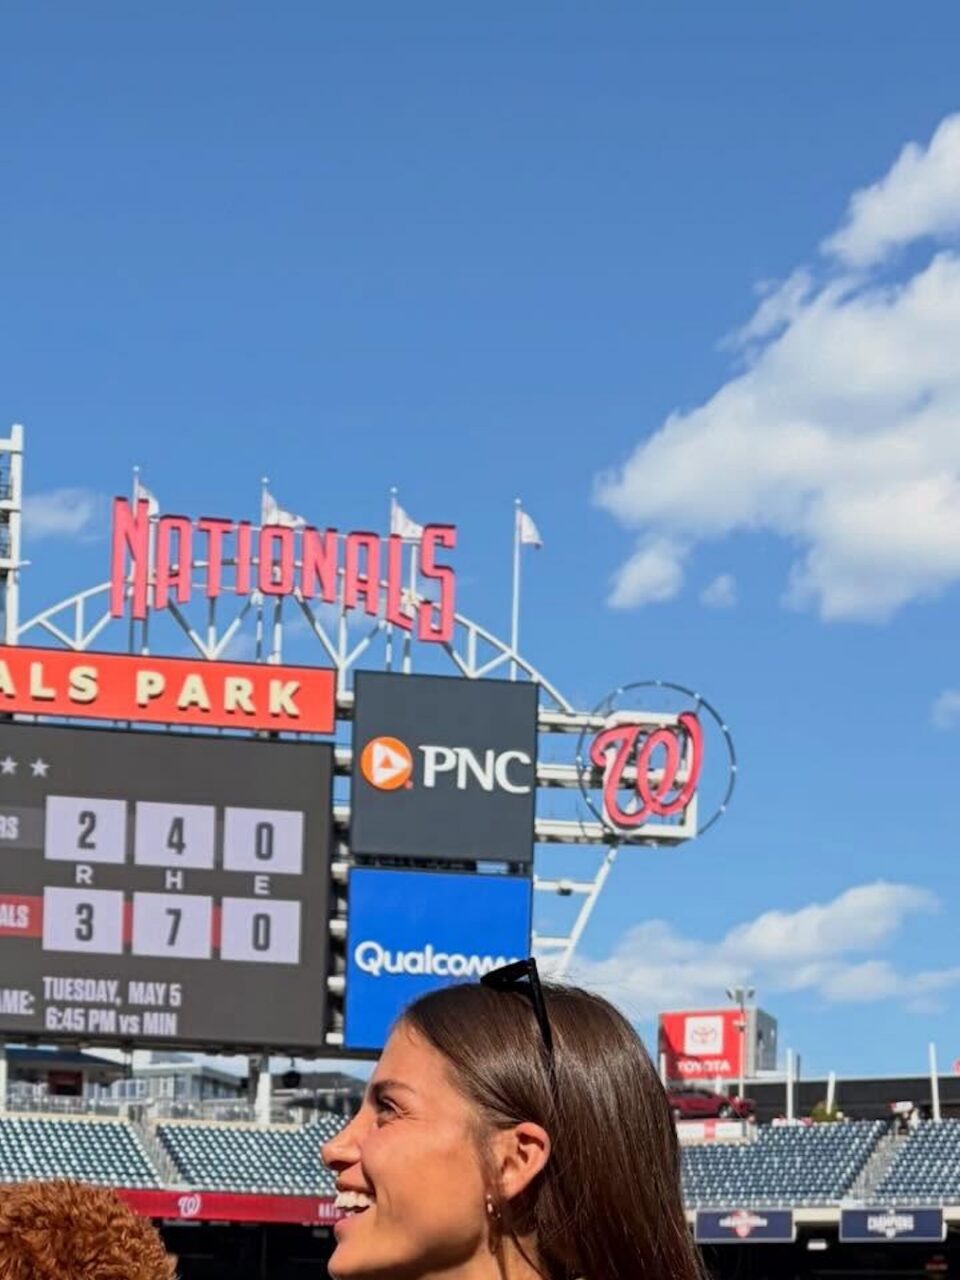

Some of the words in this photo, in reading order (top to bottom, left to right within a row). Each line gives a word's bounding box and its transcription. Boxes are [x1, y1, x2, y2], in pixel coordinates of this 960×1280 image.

[110, 497, 456, 642] NATIONALS
[136, 669, 300, 718] PARK
[418, 744, 532, 794] PNC
[78, 811, 97, 850] 2
[167, 817, 186, 856] 4
[256, 822, 274, 861] 0
[75, 865, 93, 884] R
[165, 870, 183, 890] H
[254, 875, 271, 895] E
[75, 903, 94, 942] 3
[166, 908, 183, 947] 7
[252, 913, 271, 952] 0
[43, 977, 122, 1006] TUESDAY,
[128, 981, 167, 1005] MAY
[169, 983, 182, 1006] 5
[46, 1006, 85, 1032] 6:45
[87, 1008, 116, 1033] PM
[119, 1013, 140, 1035] vs
[143, 1012, 177, 1036] MIN
[676, 1060, 731, 1073] TOYOTA
